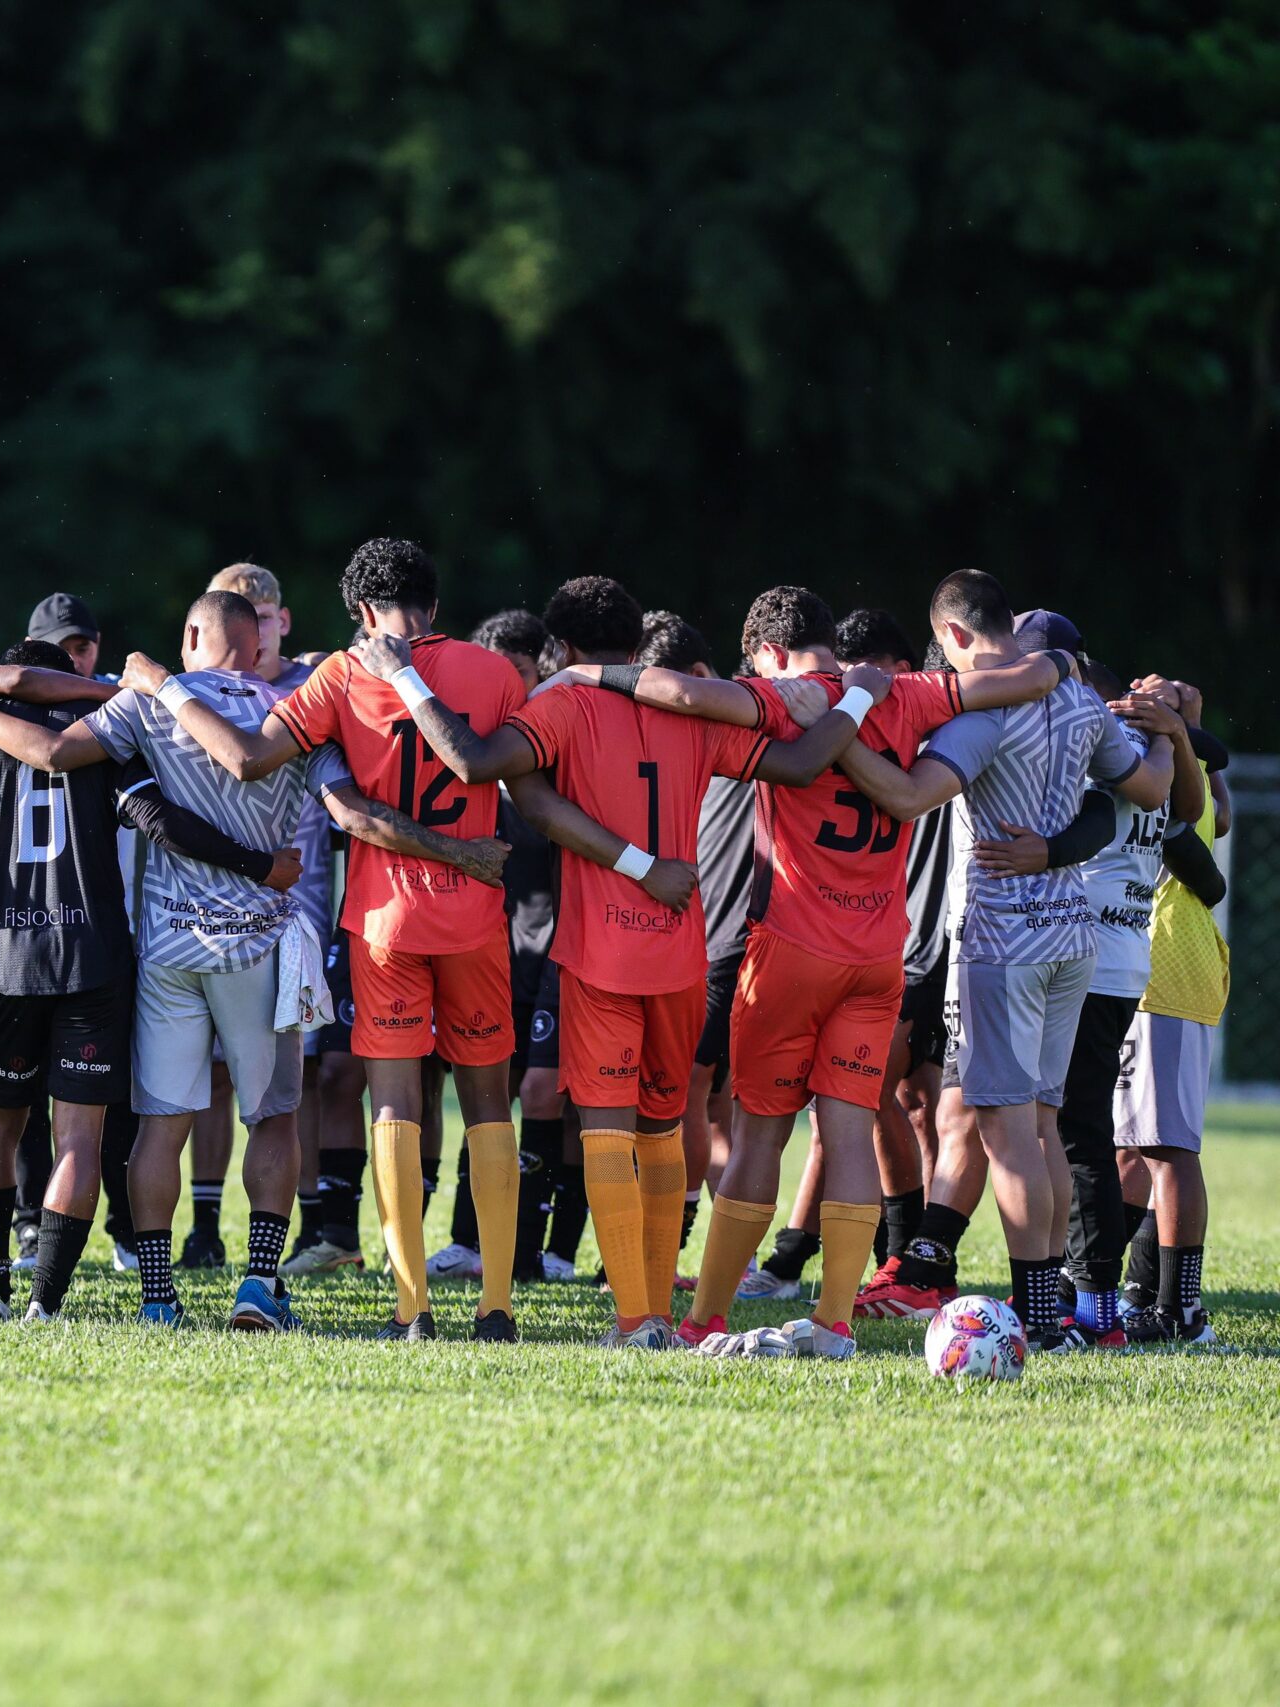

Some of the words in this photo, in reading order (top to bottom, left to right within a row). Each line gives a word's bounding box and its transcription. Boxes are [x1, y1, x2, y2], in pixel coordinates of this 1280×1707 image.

[392, 712, 469, 827] 12
[16, 760, 67, 863] 6
[638, 761, 659, 859] 1
[391, 863, 468, 888] Fisioclin
[163, 896, 196, 913] Tudo
[1009, 897, 1045, 914] Tudo
[5, 903, 85, 928] Fisioclin
[1026, 916, 1052, 931] que
[1053, 914, 1068, 926] me
[170, 918, 196, 932] que
[199, 922, 221, 935] me
[372, 1017, 386, 1026] Cia
[389, 1016, 400, 1026] do
[402, 1015, 424, 1025] corpo
[482, 1023, 502, 1035] corpo
[60, 1058, 74, 1069] Cia
[76, 1061, 87, 1071] do
[89, 1063, 111, 1074] corpo
[599, 1066, 616, 1076] Cia
[618, 1066, 628, 1075] do
[831, 1055, 847, 1067] Cia
[848, 1060, 861, 1071] do
[7, 1070, 19, 1080] do
[775, 1078, 791, 1087] Cia
